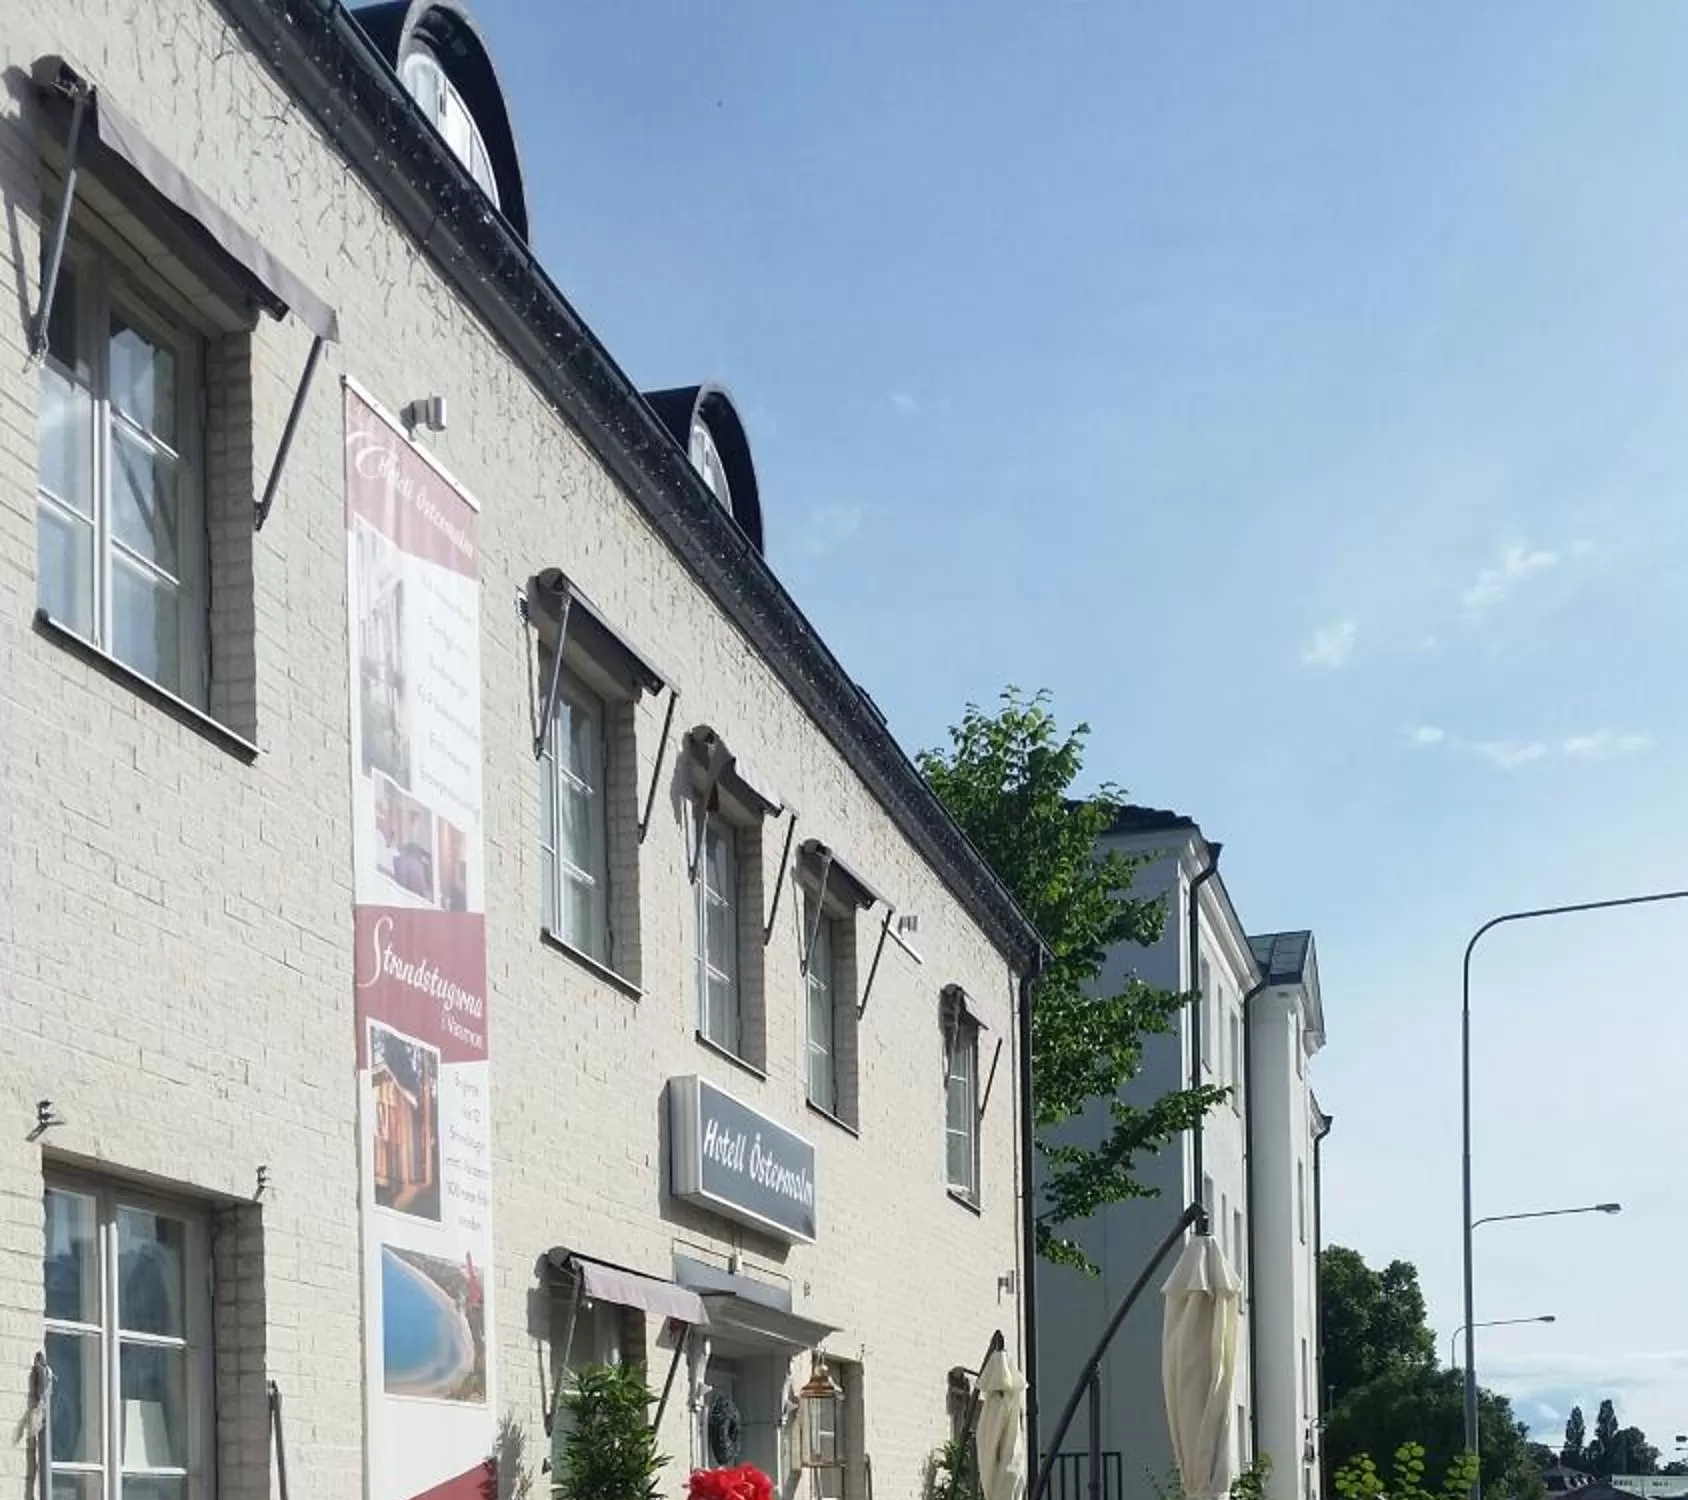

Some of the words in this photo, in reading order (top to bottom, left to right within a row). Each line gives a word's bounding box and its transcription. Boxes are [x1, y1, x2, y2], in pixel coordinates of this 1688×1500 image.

[357, 916, 483, 1019] Strandstugorna
[703, 1118, 747, 1173] Hotell
[749, 1131, 813, 1205] Östermalm
